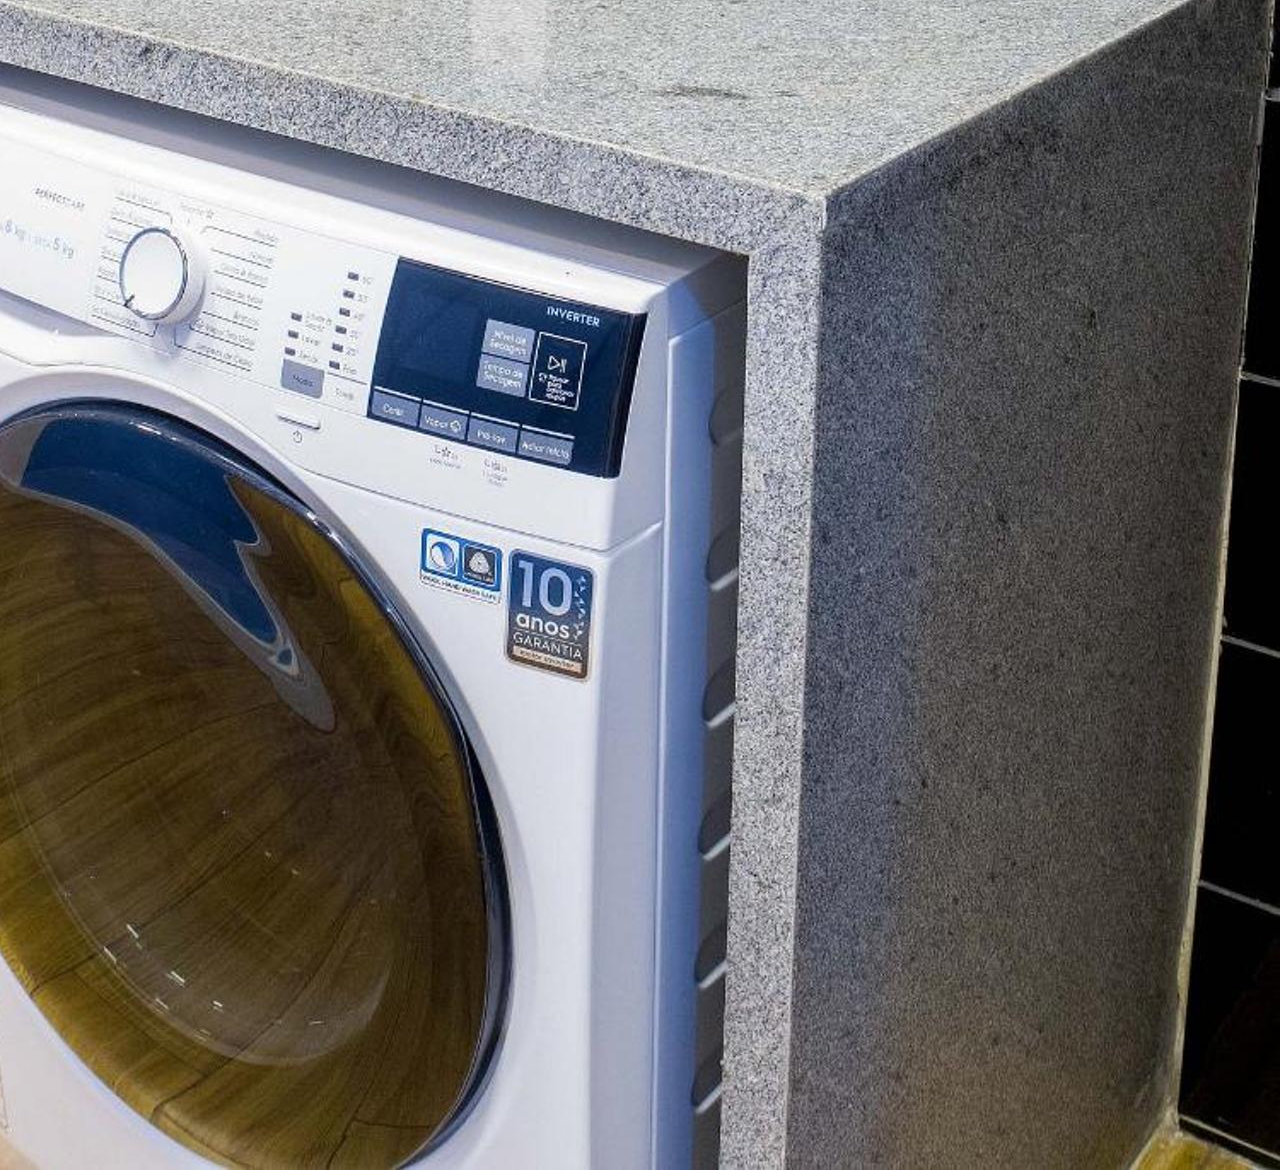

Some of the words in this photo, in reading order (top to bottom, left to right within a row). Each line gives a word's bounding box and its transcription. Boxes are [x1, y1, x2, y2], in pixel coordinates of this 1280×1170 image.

[546, 306, 601, 328] INVERTER
[518, 559, 572, 616] 10
[516, 612, 570, 640] anos
[512, 631, 584, 660] GARANTIA
